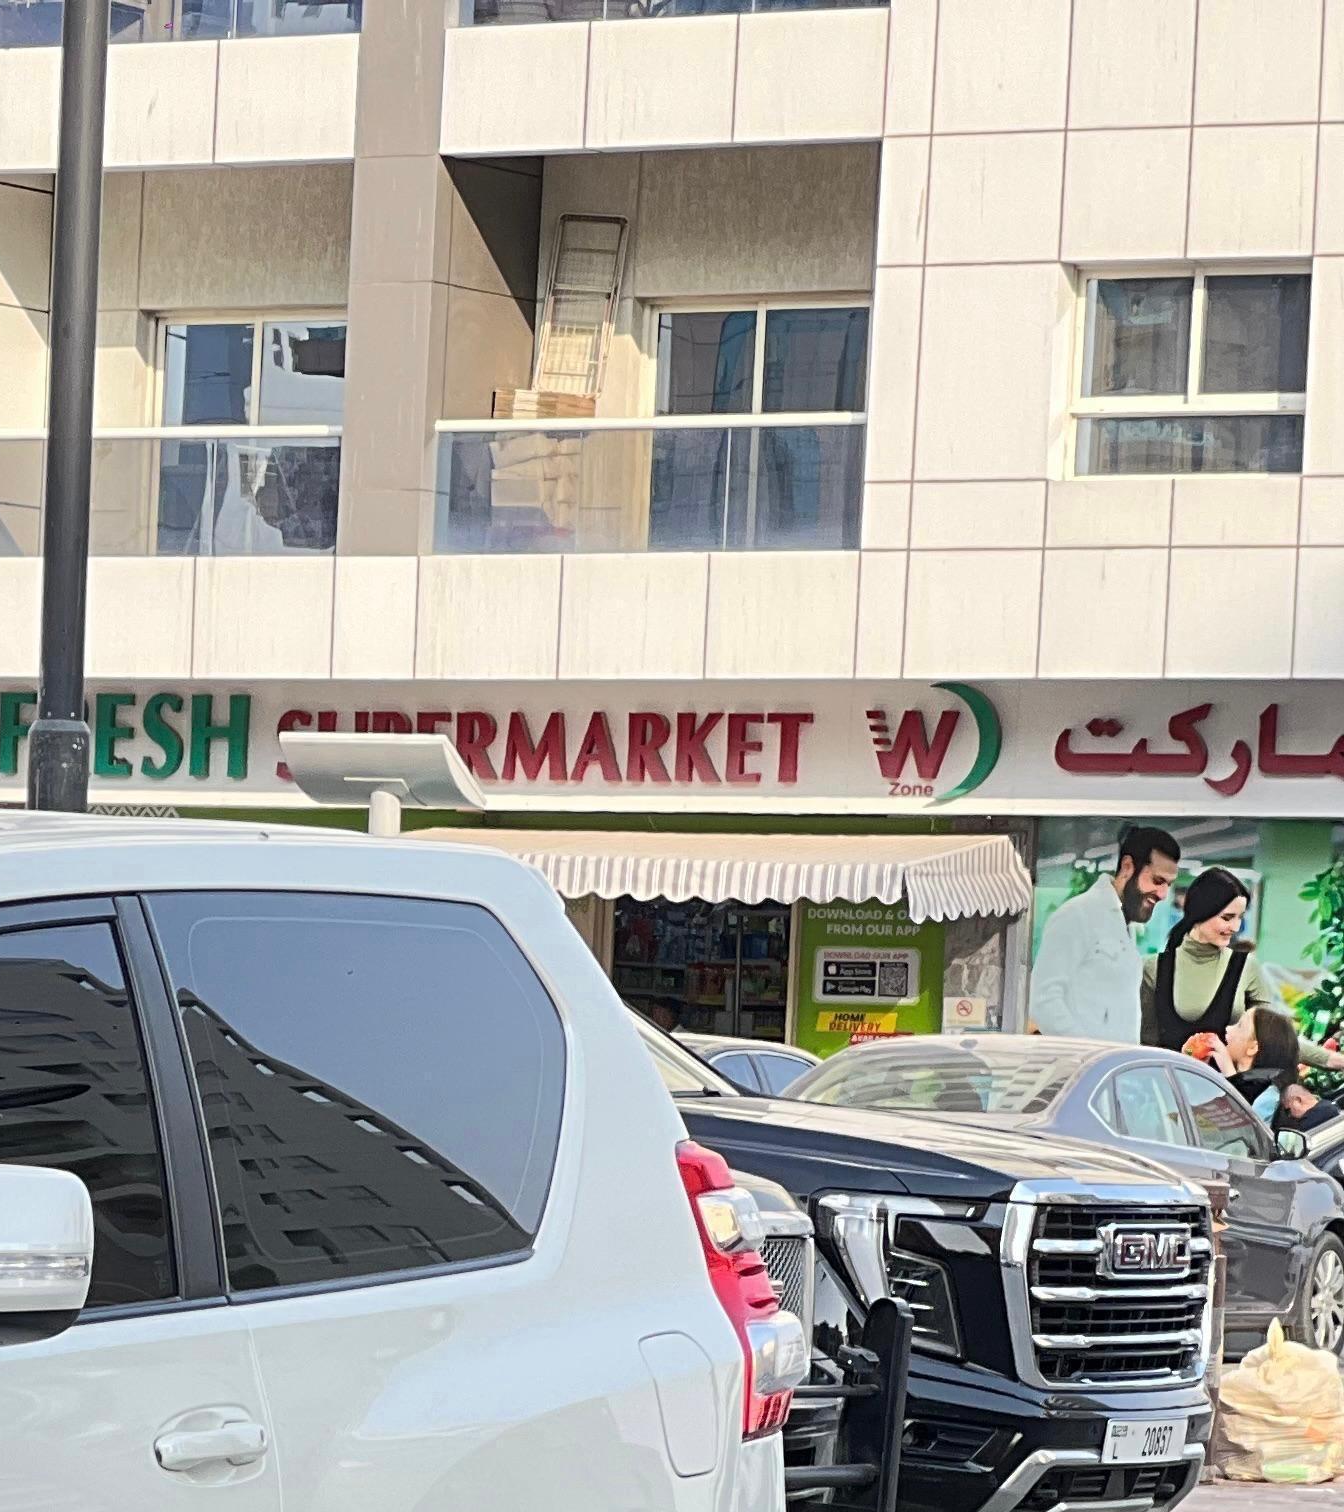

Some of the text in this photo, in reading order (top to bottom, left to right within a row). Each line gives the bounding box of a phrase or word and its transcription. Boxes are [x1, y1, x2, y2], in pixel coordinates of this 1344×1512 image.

[889, 781, 934, 797] Zone
[807, 908, 883, 920] DOWNLOAD
[885, 910, 894, 920] &
[826, 924, 920, 937] FROM OUR APP
[833, 1012, 867, 1022] HOME
[828, 1021, 882, 1032] DELIVERY
[1114, 1232, 1191, 1270] GMC
[1112, 1441, 1118, 1460] L
